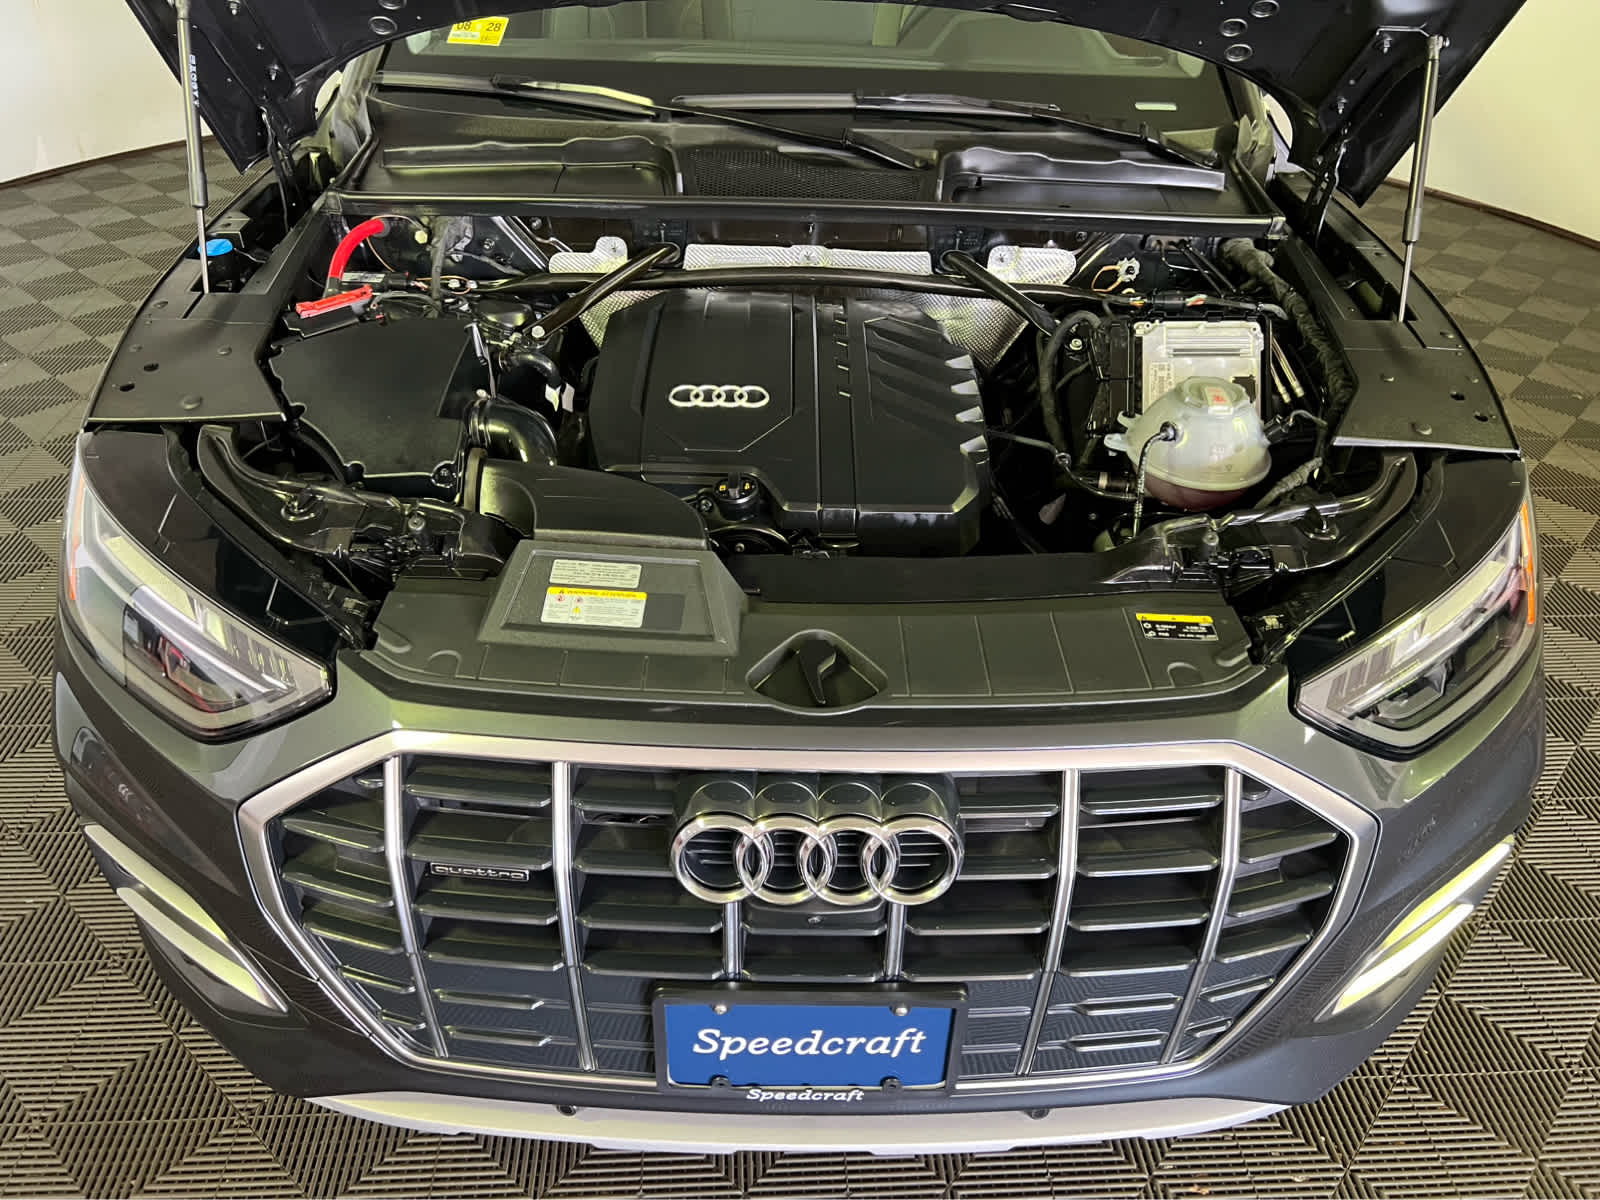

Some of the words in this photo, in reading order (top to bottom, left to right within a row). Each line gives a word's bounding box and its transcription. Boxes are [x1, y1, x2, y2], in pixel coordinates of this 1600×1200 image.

[486, 22, 502, 32] 28
[434, 865, 524, 880] quattro
[692, 1027, 927, 1061] Speedcraft
[746, 1088, 864, 1102] Speedcraft
